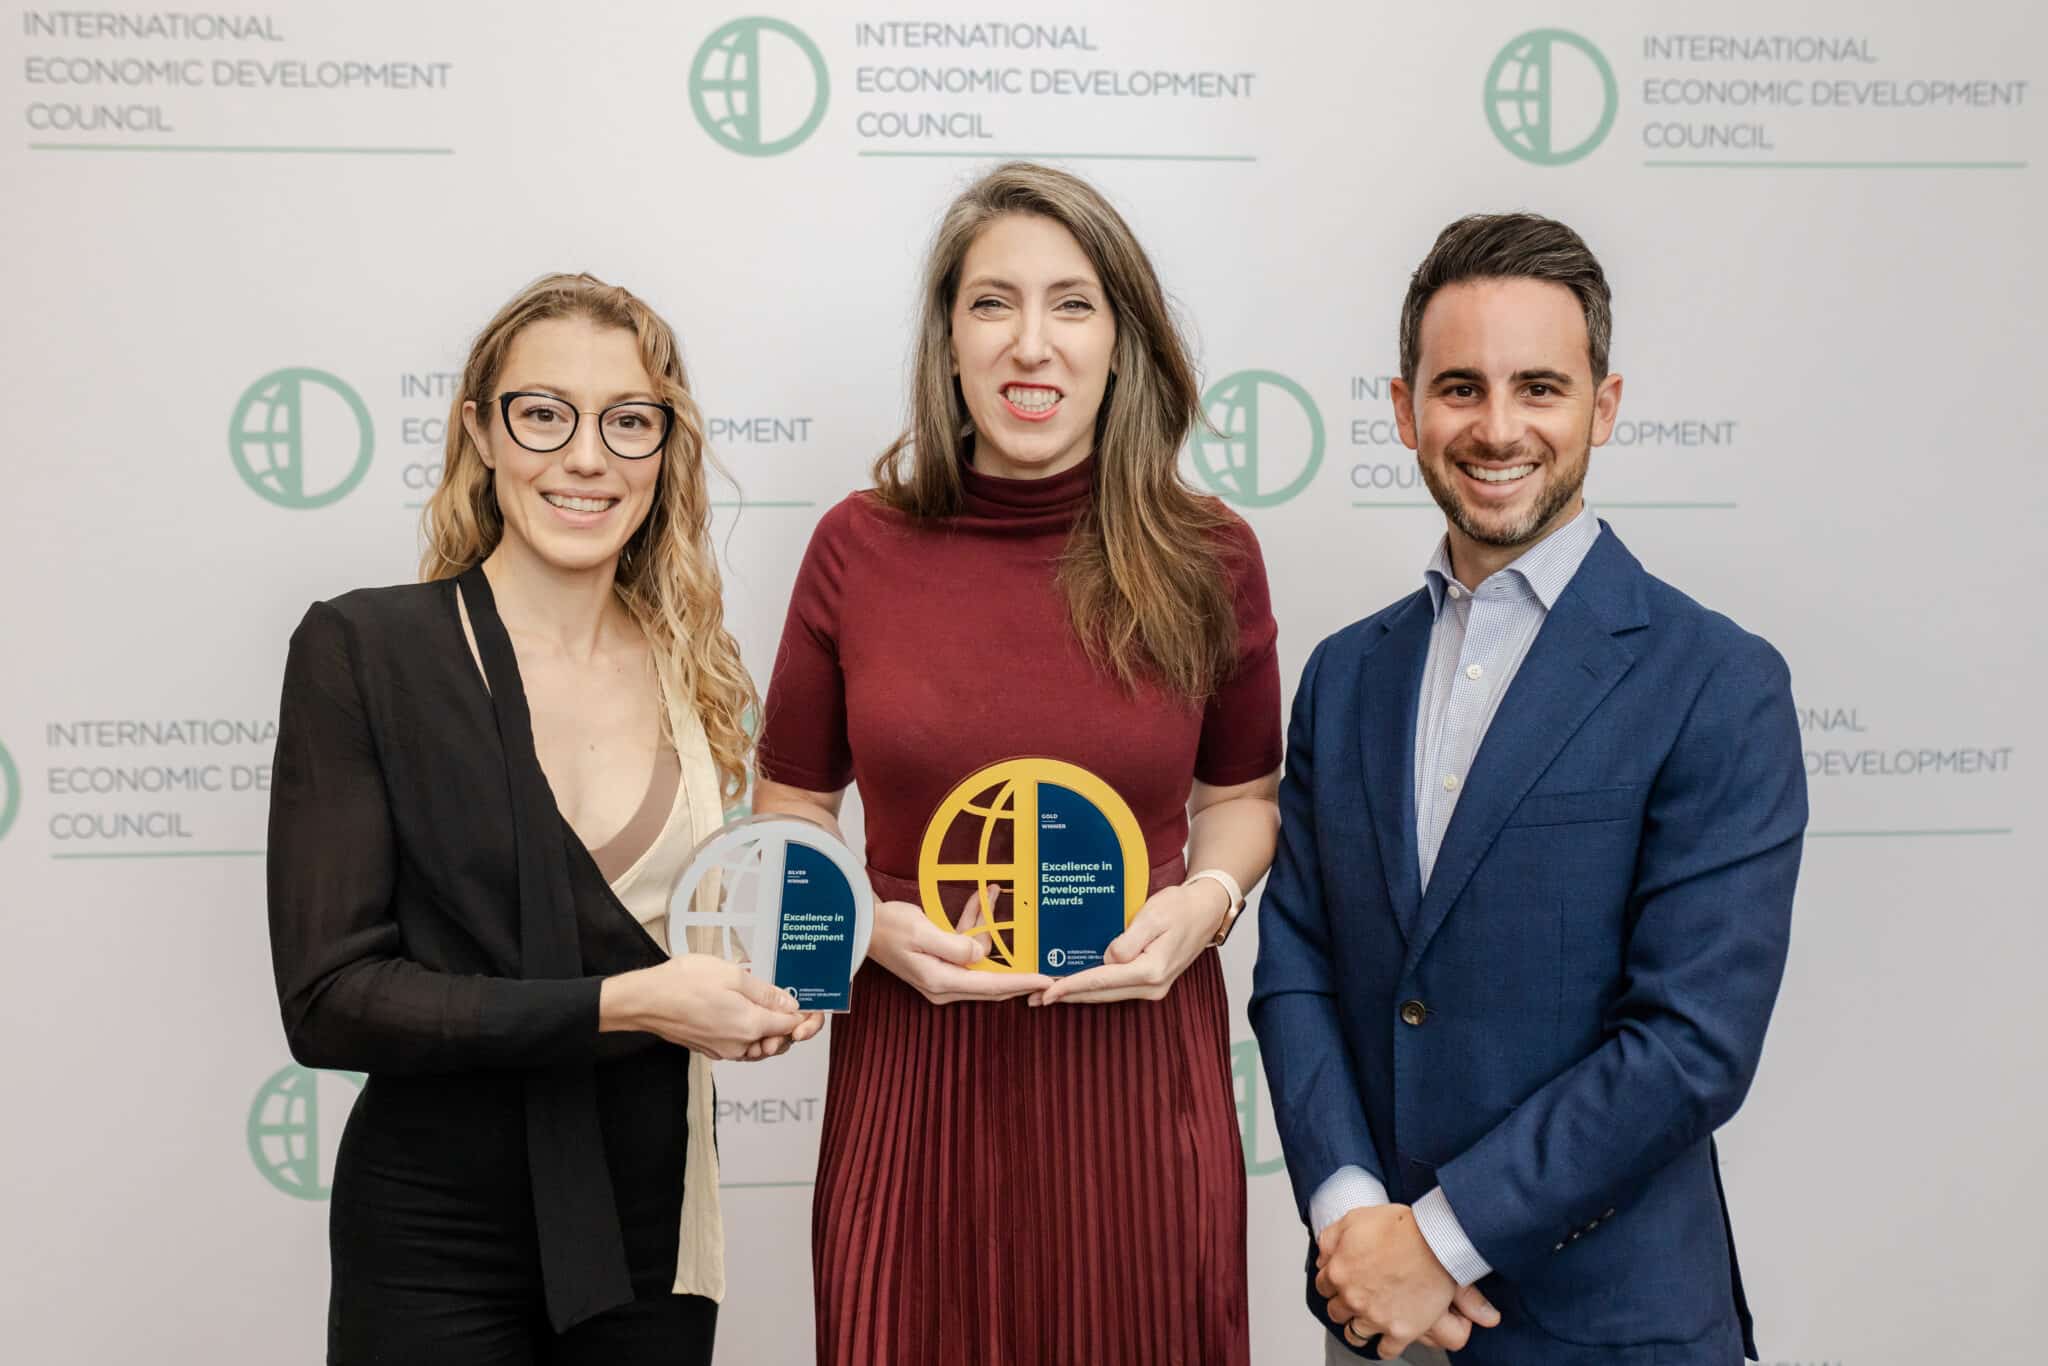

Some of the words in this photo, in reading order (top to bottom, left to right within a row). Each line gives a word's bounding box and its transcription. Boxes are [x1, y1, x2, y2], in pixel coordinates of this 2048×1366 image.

[23, 11, 284, 41] INTERNATIONAL
[855, 22, 1097, 51] INTERNATIONAL
[1643, 35, 1877, 63] INTERNATIONAL
[24, 57, 204, 87] ECONOMIC
[211, 60, 453, 89] DEVELOPMENT
[855, 66, 1022, 95] ECONOMIC
[1030, 69, 1257, 98] DEVELOPMENT
[1642, 78, 1803, 106] ECONOMIC
[1810, 79, 2029, 107] DEVELOPMENT
[25, 103, 174, 132] COUNCIL
[855, 111, 993, 139] COUNCIL
[1642, 122, 1774, 149] COUNCIL
[1351, 377, 1392, 400] INT
[708, 418, 814, 443] PMENT
[47, 719, 278, 747] INTERNATIONA
[48, 765, 222, 794] ECONOMIC
[231, 764, 271, 792] DE
[49, 812, 193, 840] COUNCIL
[1041, 861, 1100, 871] Excellence
[1102, 861, 1113, 871] in
[1041, 873, 1096, 883] Economic
[1041, 884, 1115, 895] Development
[1041, 896, 1084, 905] Awards
[783, 913, 833, 922] Excellence
[835, 913, 844, 922] in
[783, 923, 829, 931] Economic
[781, 943, 816, 951] Awards
[782, 933, 844, 942] Development
[717, 1097, 819, 1123] PMENT
